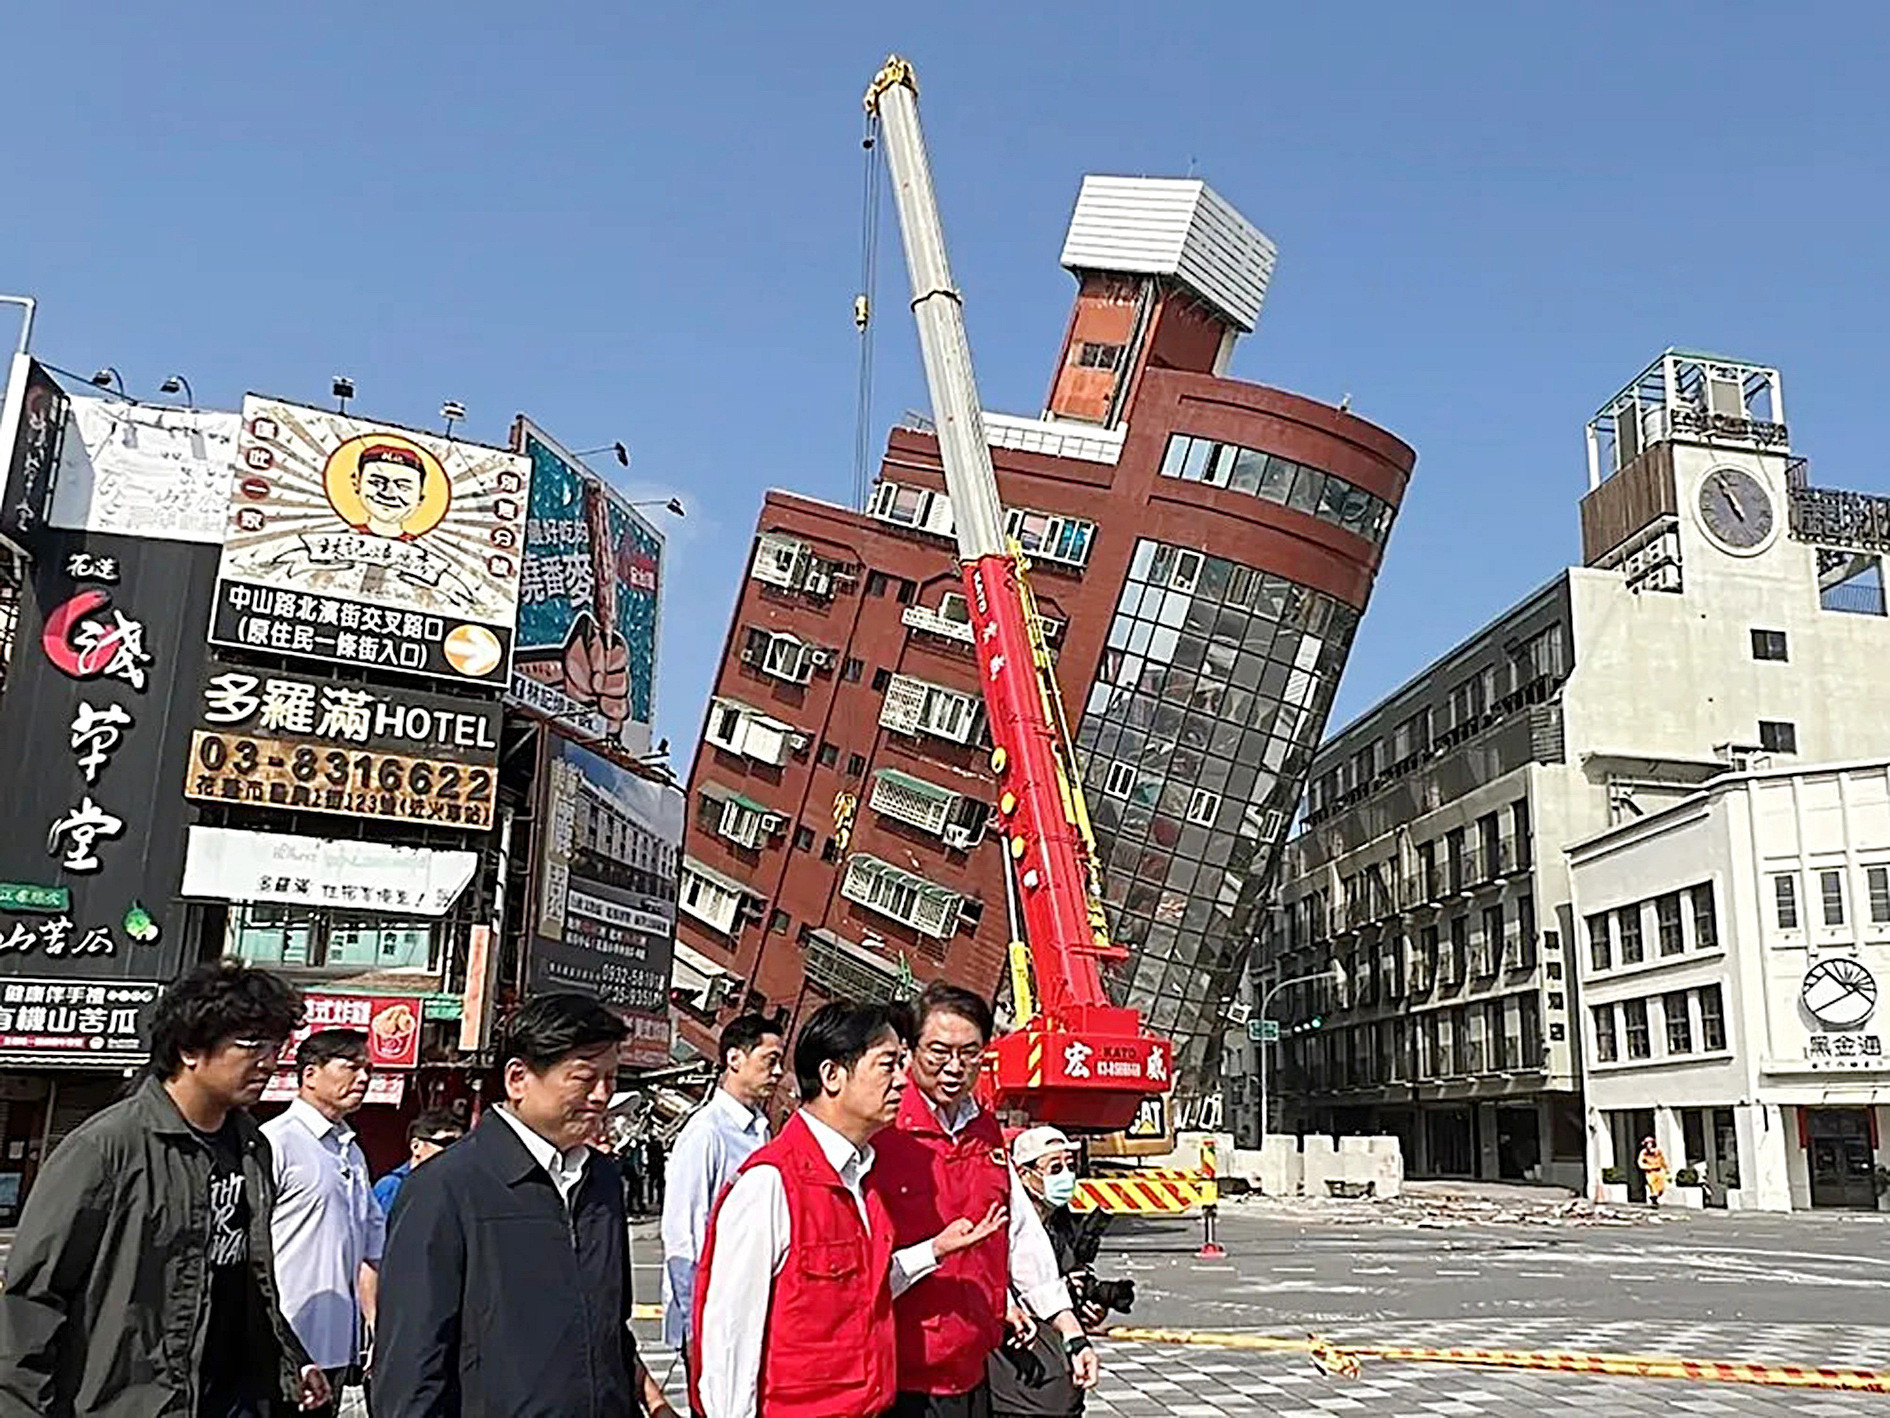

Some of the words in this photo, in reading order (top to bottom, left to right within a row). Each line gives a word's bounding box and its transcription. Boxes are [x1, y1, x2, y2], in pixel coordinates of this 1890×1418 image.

[228, 585, 444, 643] 中山路北濱街交叉路口
[237, 616, 428, 669] (原住民一條街入口)
[200, 735, 492, 800] 03-8316622
[1062, 1040, 1093, 1079] 宏
[1102, 1046, 1137, 1060] KATO
[1146, 1044, 1168, 1082] 威
